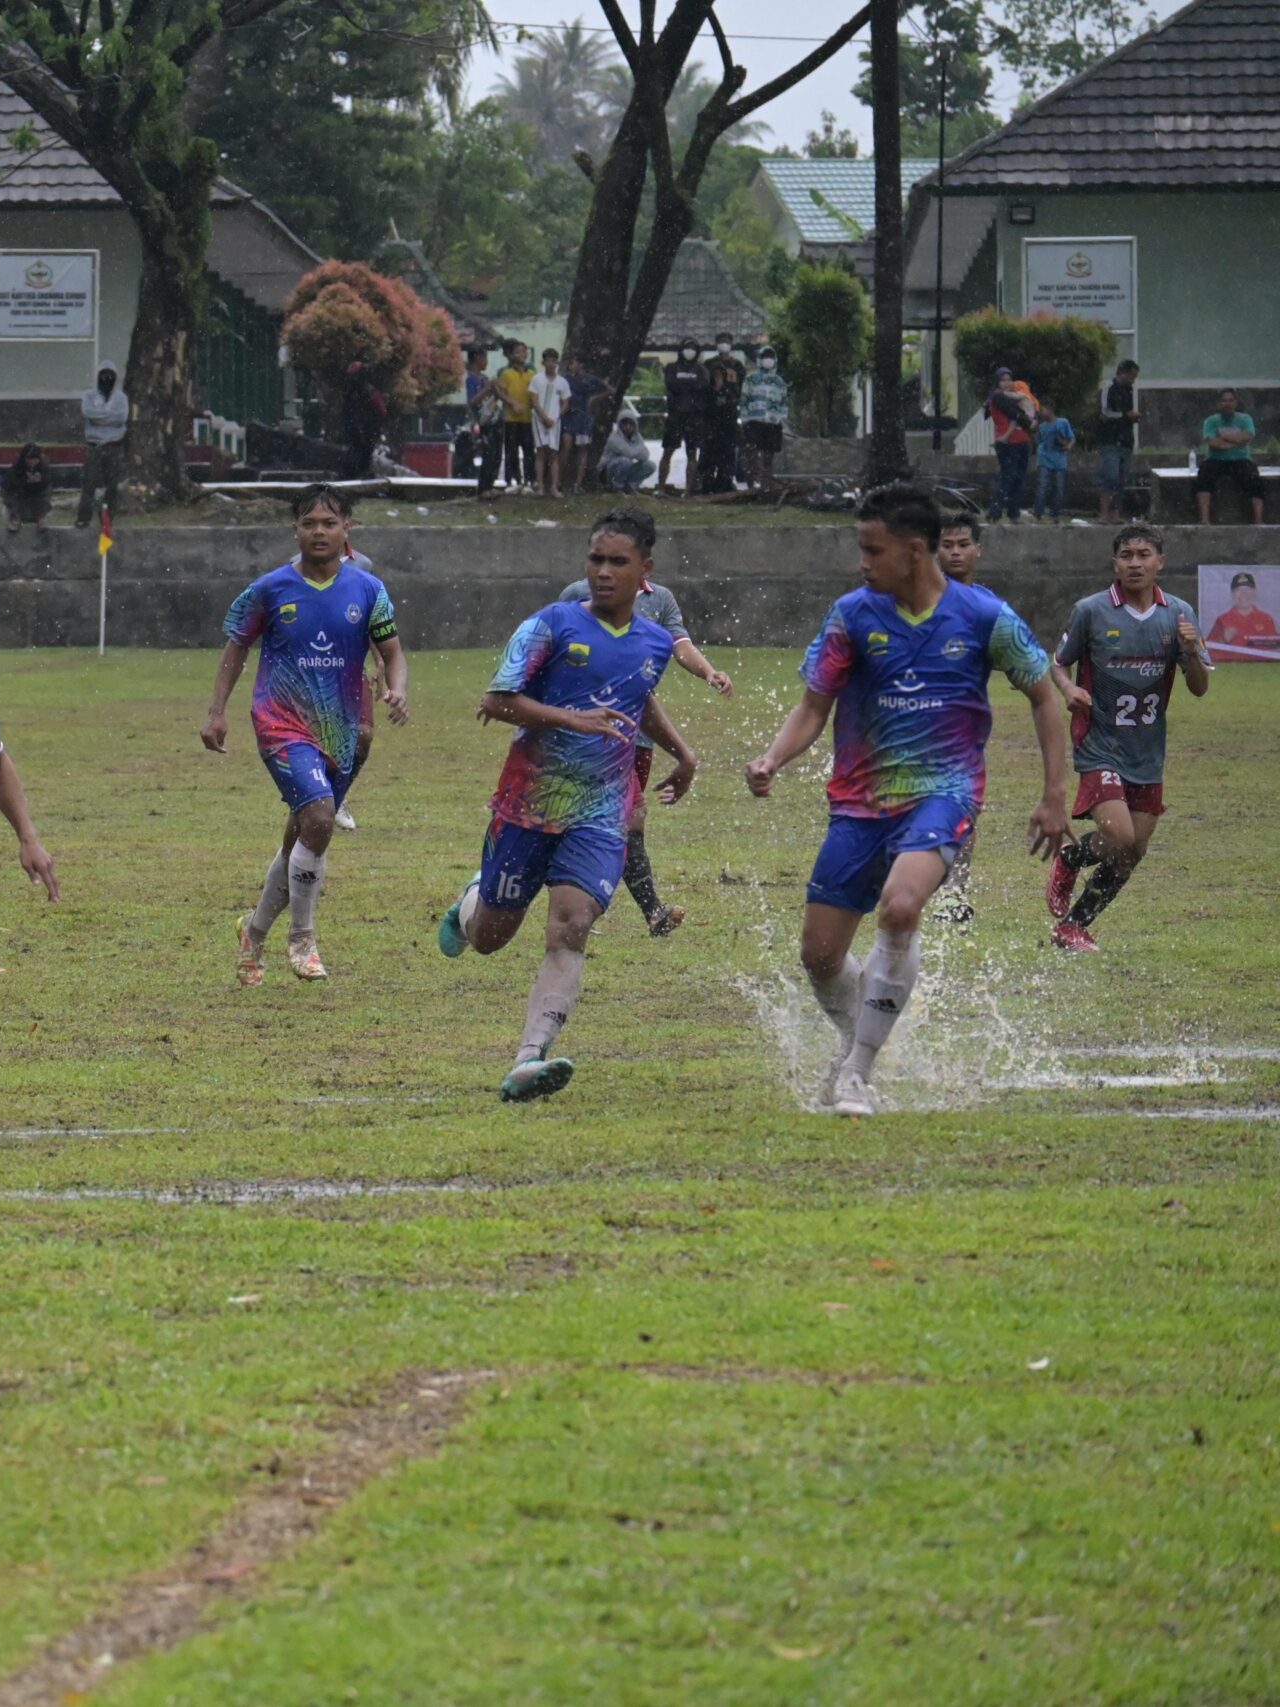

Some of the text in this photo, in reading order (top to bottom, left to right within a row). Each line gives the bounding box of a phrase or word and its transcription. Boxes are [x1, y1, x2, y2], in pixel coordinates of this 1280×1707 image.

[298, 656, 345, 668] AURORA
[878, 696, 942, 711] AURORA
[1115, 693, 1160, 726] 23
[310, 768, 327, 787] 4
[1101, 771, 1121, 786] 23
[497, 870, 523, 899] 16
